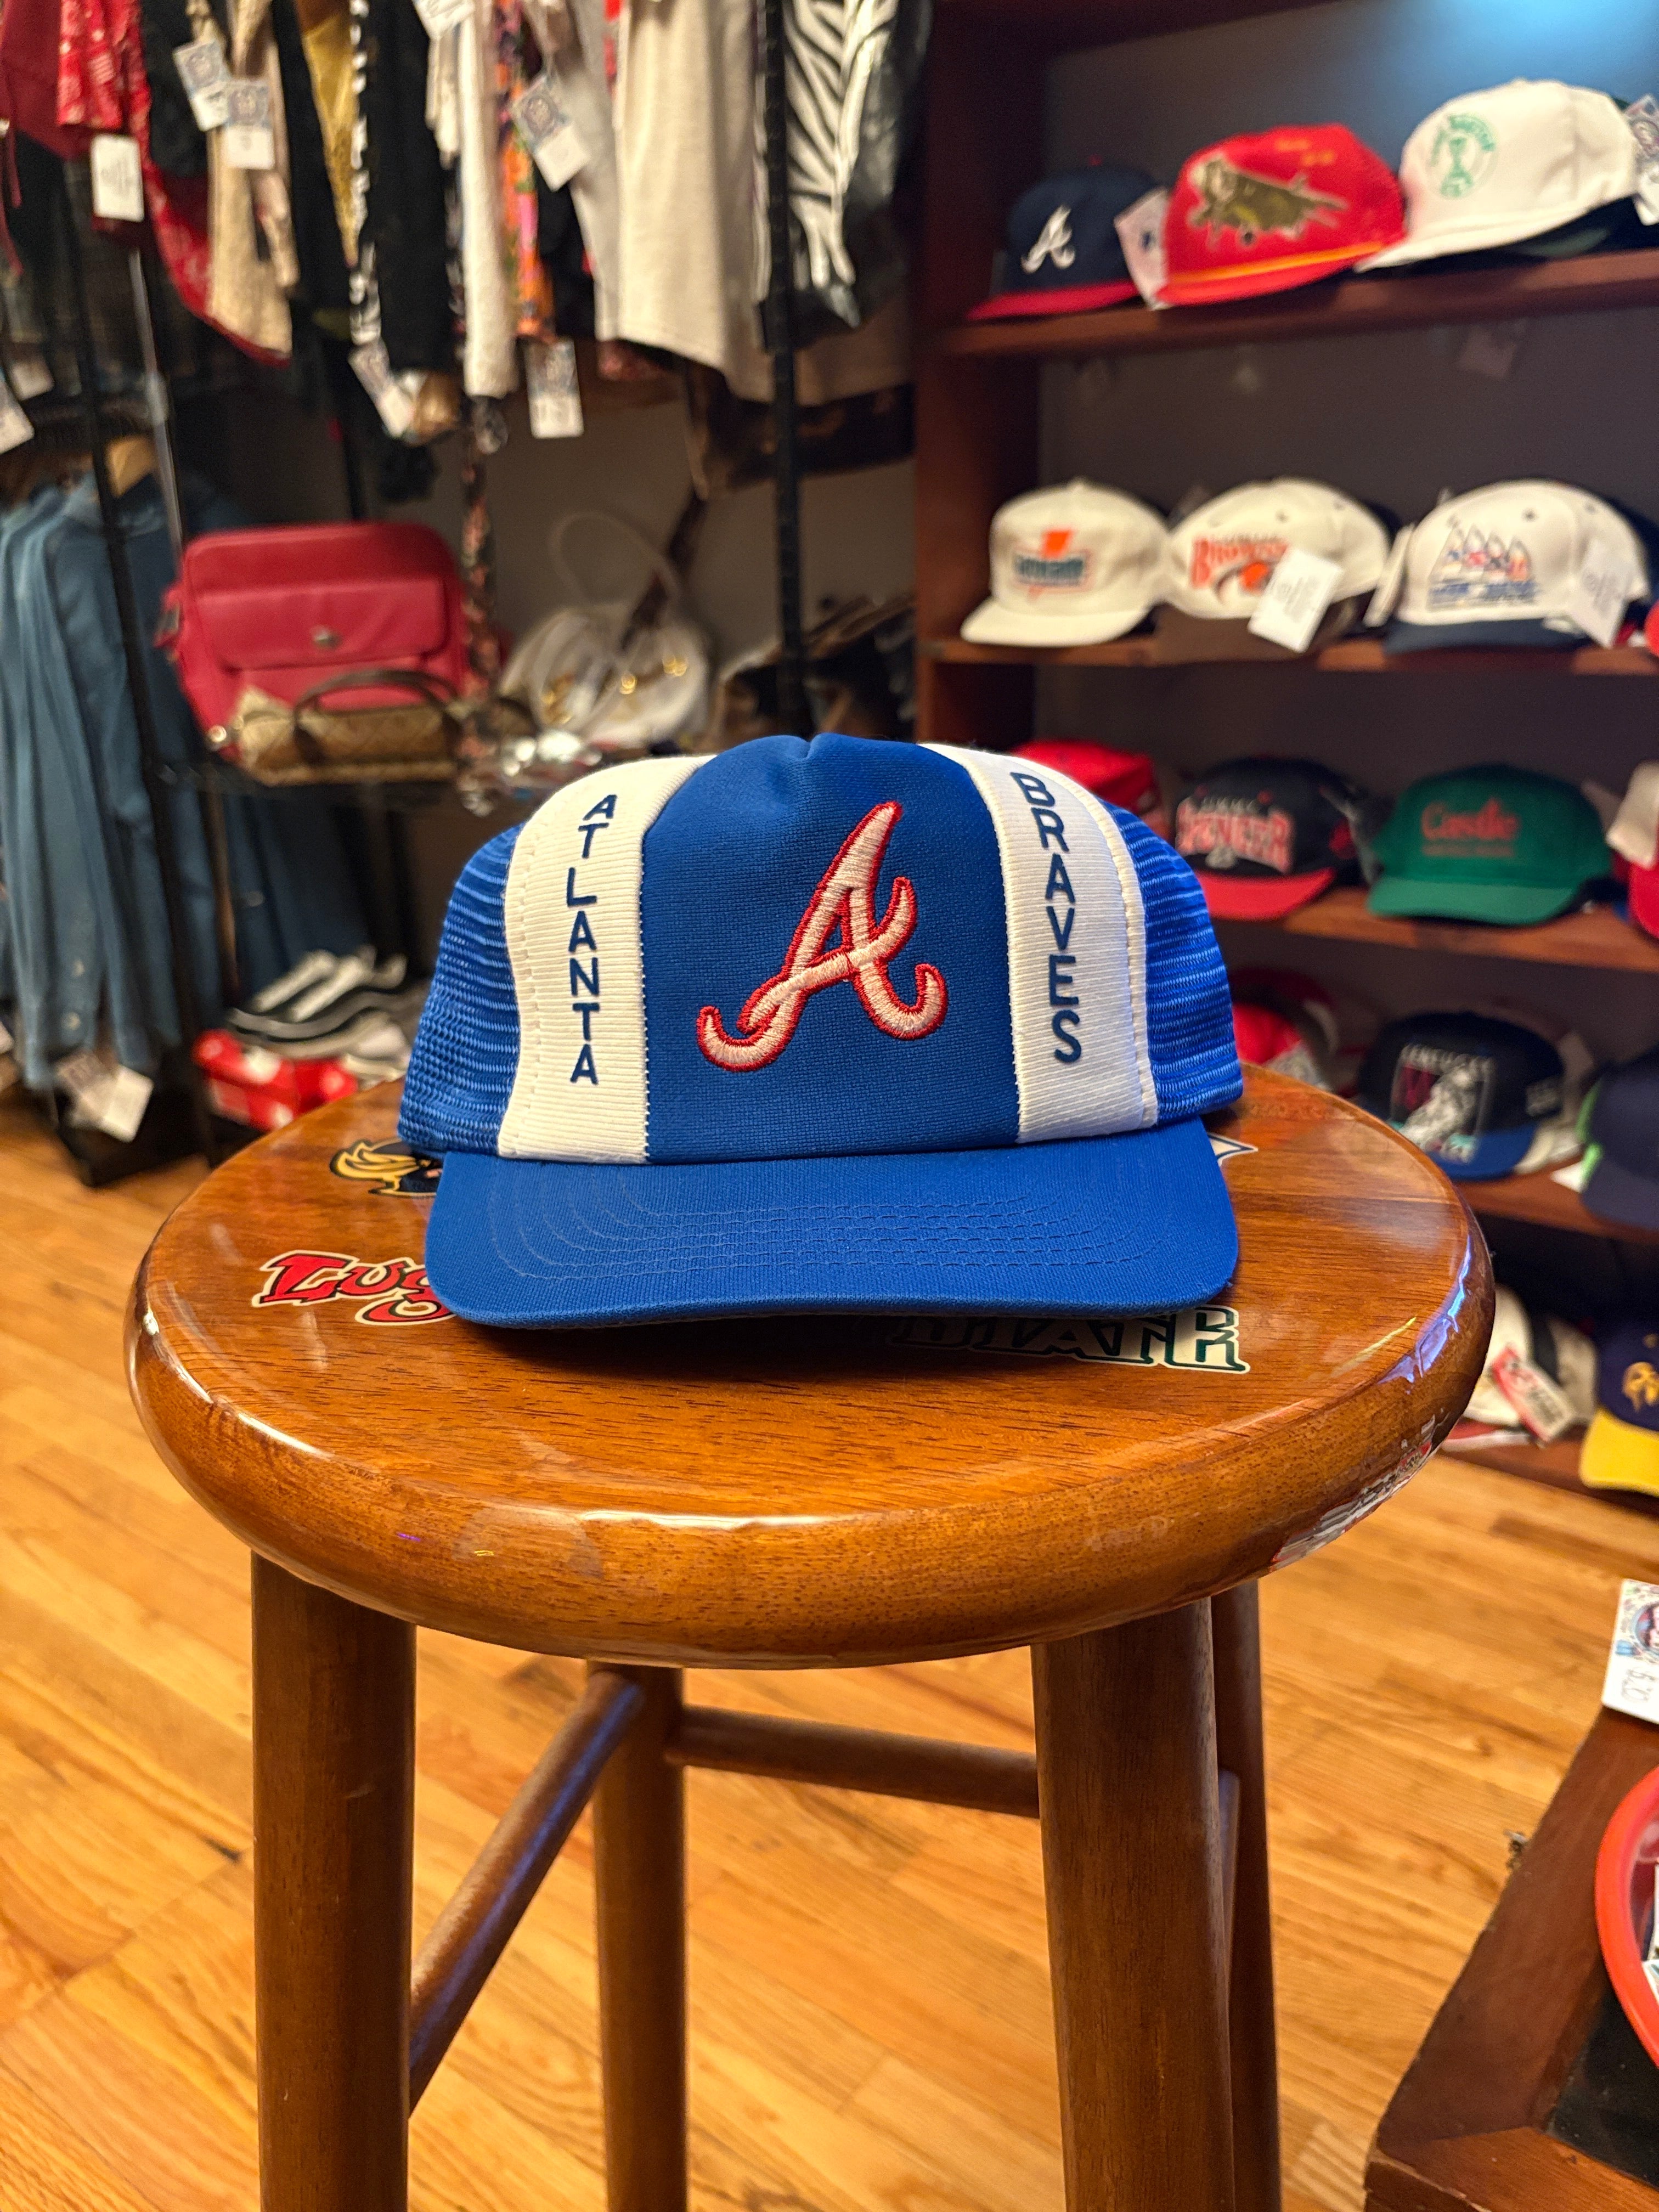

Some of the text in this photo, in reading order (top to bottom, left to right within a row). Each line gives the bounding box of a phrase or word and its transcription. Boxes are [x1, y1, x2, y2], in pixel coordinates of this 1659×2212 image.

[566, 794, 618, 1085] ATLANTA
[696, 800, 949, 1072] A
[1010, 771, 1082, 1063] BRAVES
